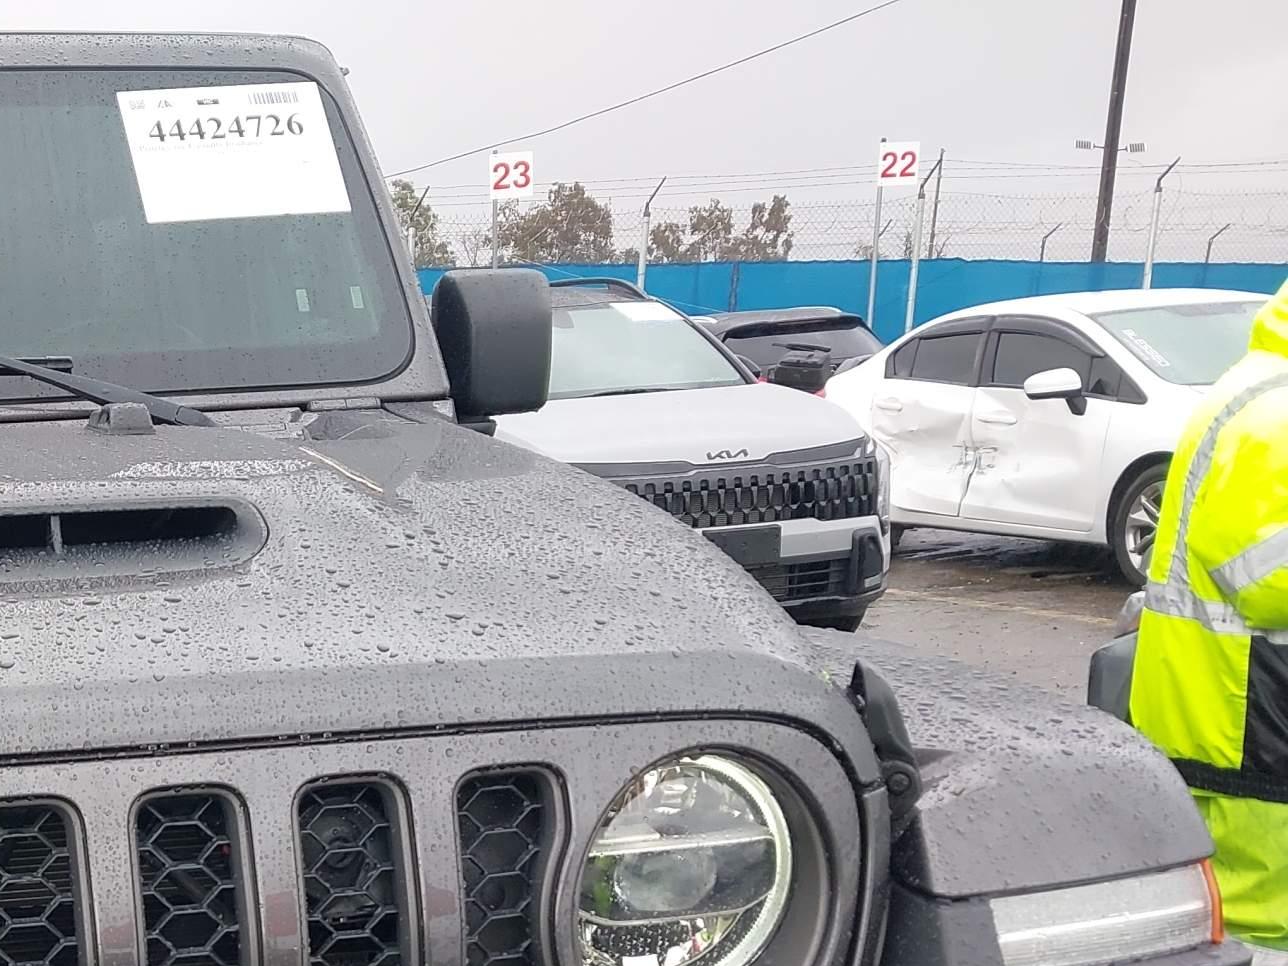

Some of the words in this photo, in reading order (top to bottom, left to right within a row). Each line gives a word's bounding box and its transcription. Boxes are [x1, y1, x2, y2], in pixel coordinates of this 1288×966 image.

[149, 113, 304, 142] 44424726
[493, 160, 531, 190] 23
[881, 151, 917, 178] 22
[706, 449, 749, 460] KIA
